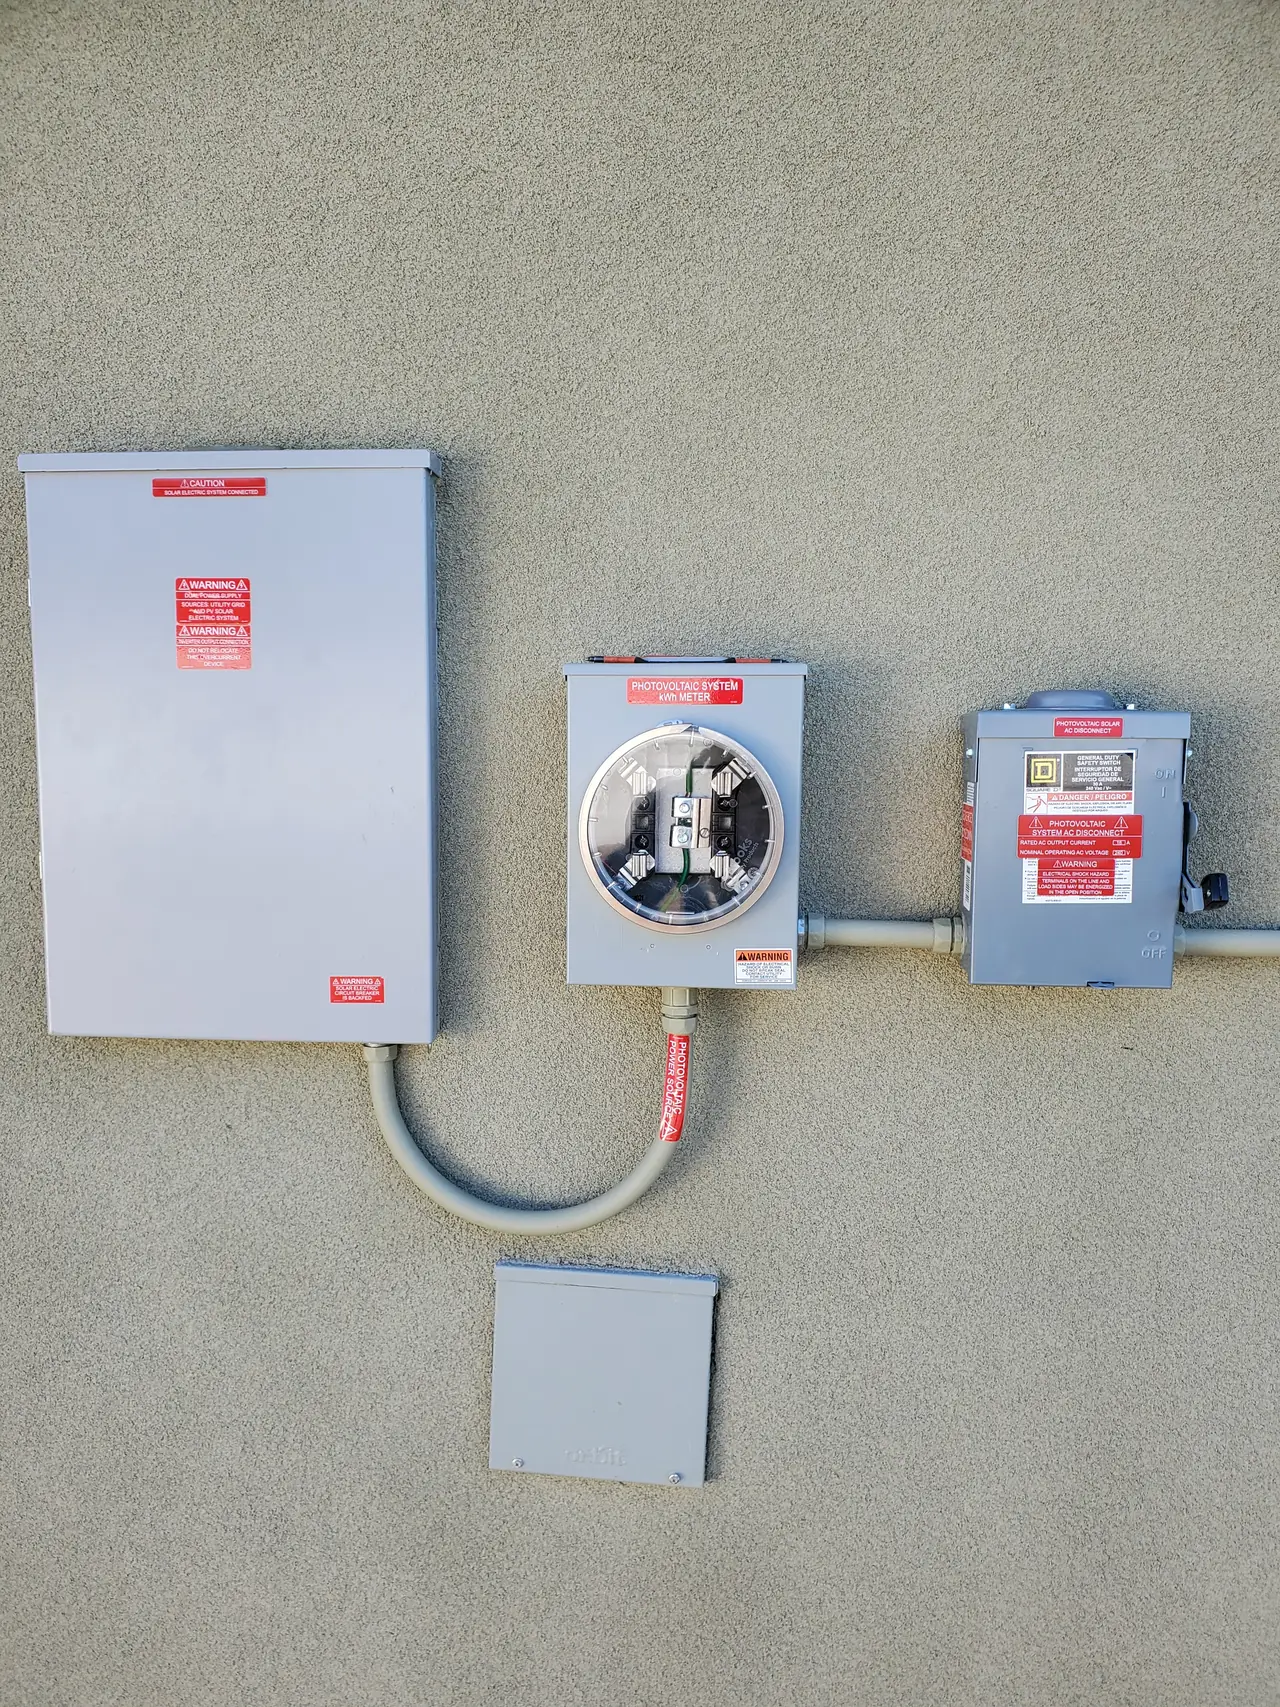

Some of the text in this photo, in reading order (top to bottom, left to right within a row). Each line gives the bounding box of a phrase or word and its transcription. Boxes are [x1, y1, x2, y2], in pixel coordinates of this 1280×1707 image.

[189, 580, 236, 590] WARNING
[190, 626, 236, 636] WARNING
[631, 682, 738, 691] PHOTOVOLTAIC SYSTEM
[659, 692, 711, 702] kWh METER
[747, 952, 789, 961] WARNING
[1140, 946, 1167, 960] OFF
[665, 1040, 676, 1118] POWER SOURCE
[674, 1042, 687, 1115] PHOTOVOLTAIC
